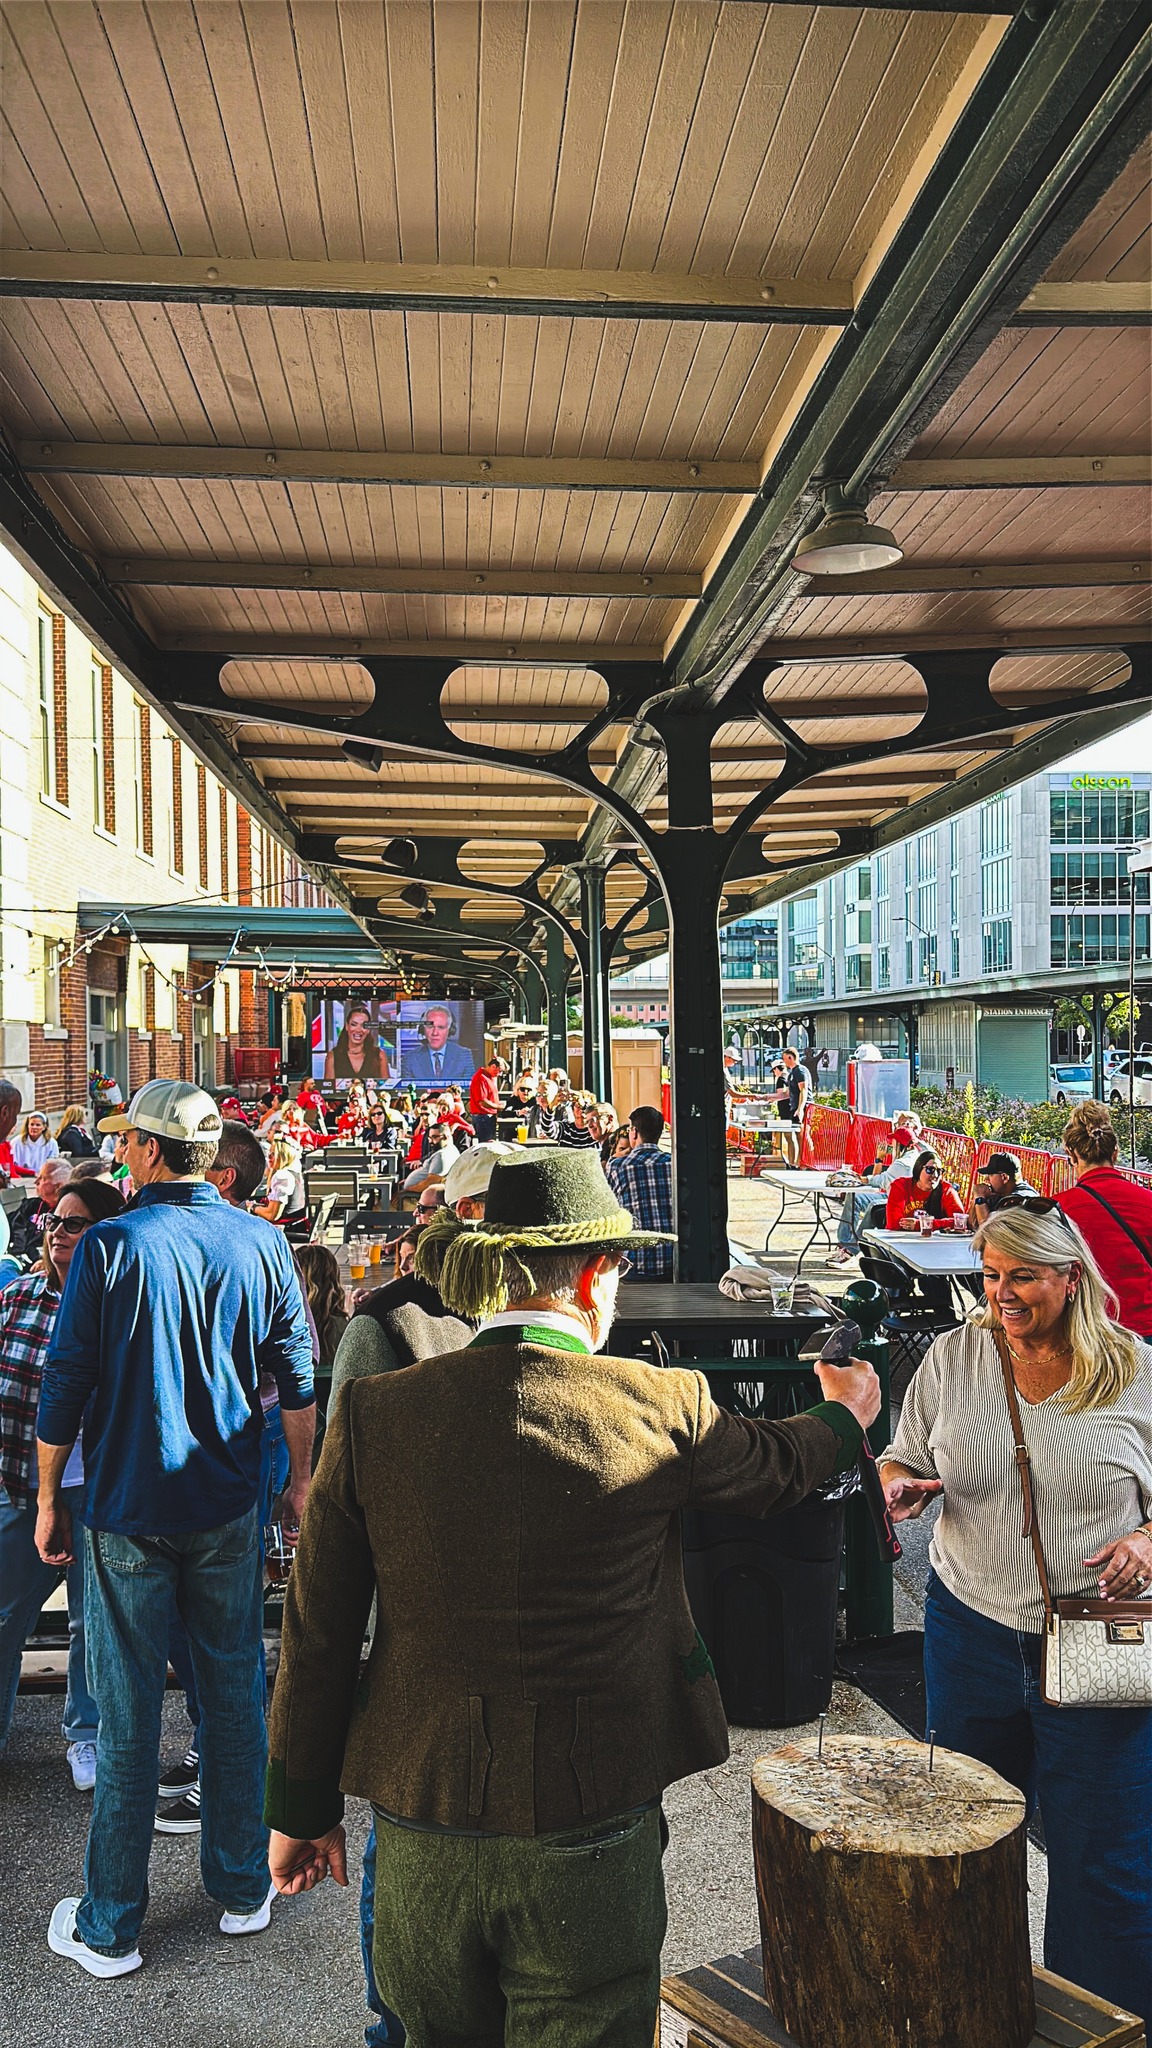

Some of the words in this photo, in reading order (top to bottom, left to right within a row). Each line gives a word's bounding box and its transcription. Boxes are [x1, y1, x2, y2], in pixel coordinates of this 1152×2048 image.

[1072, 773, 1131, 790] olsson
[984, 1008, 1013, 1016] STATION
[1015, 1008, 1050, 1016] ENTRANCE
[904, 1200, 925, 1214] KANSA
